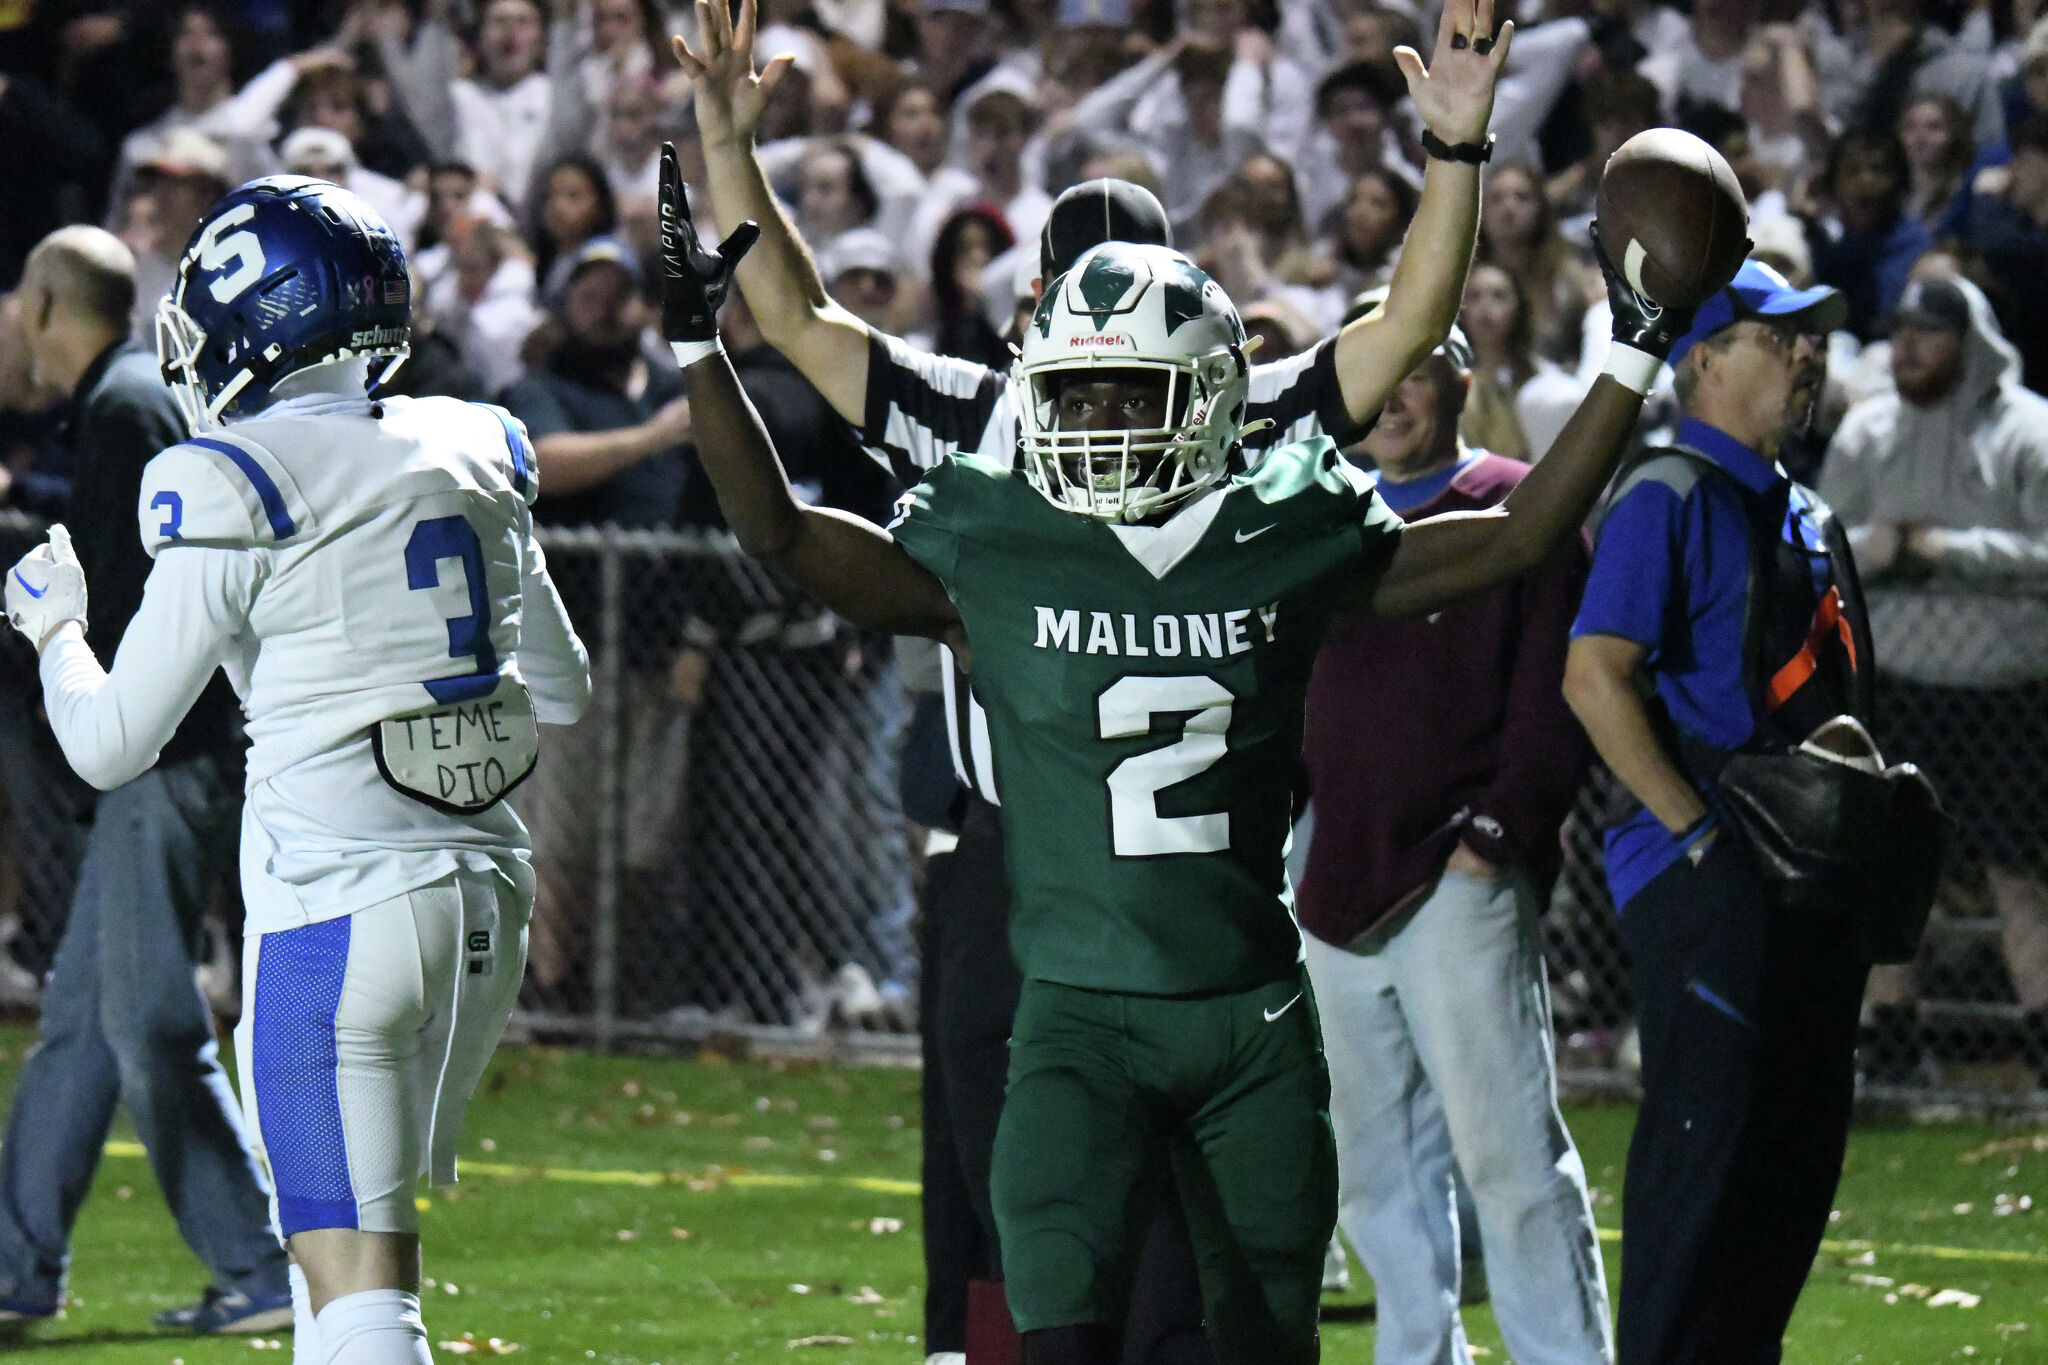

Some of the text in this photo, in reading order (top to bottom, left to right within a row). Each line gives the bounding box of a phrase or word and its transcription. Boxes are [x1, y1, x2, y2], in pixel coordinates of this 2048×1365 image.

[201, 203, 266, 304] S
[661, 202, 684, 278] VAPOR
[151, 491, 183, 541] 3
[404, 515, 500, 705] 3
[1034, 601, 1280, 659] MALONEY
[396, 702, 510, 750] TEME
[437, 757, 505, 805] DIO
[1099, 676, 1235, 856] 2
